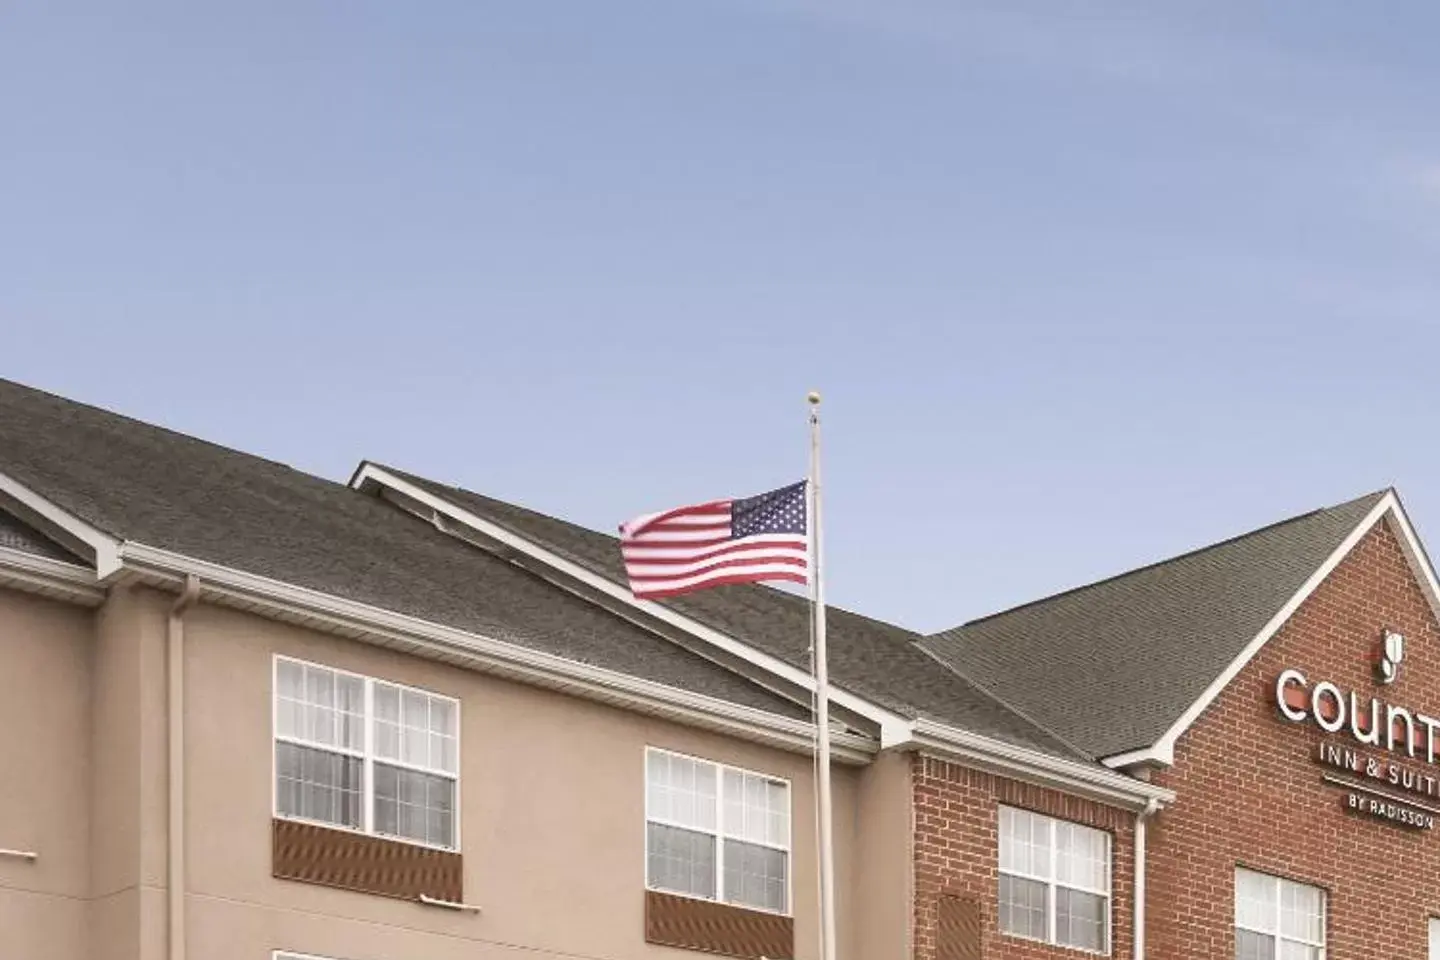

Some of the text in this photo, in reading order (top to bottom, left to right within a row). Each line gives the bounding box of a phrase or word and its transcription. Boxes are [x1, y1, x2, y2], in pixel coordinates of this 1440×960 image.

[1319, 742, 1357, 771] INN
[1366, 757, 1379, 777] &
[1349, 793, 1434, 830] BY RADISSON
